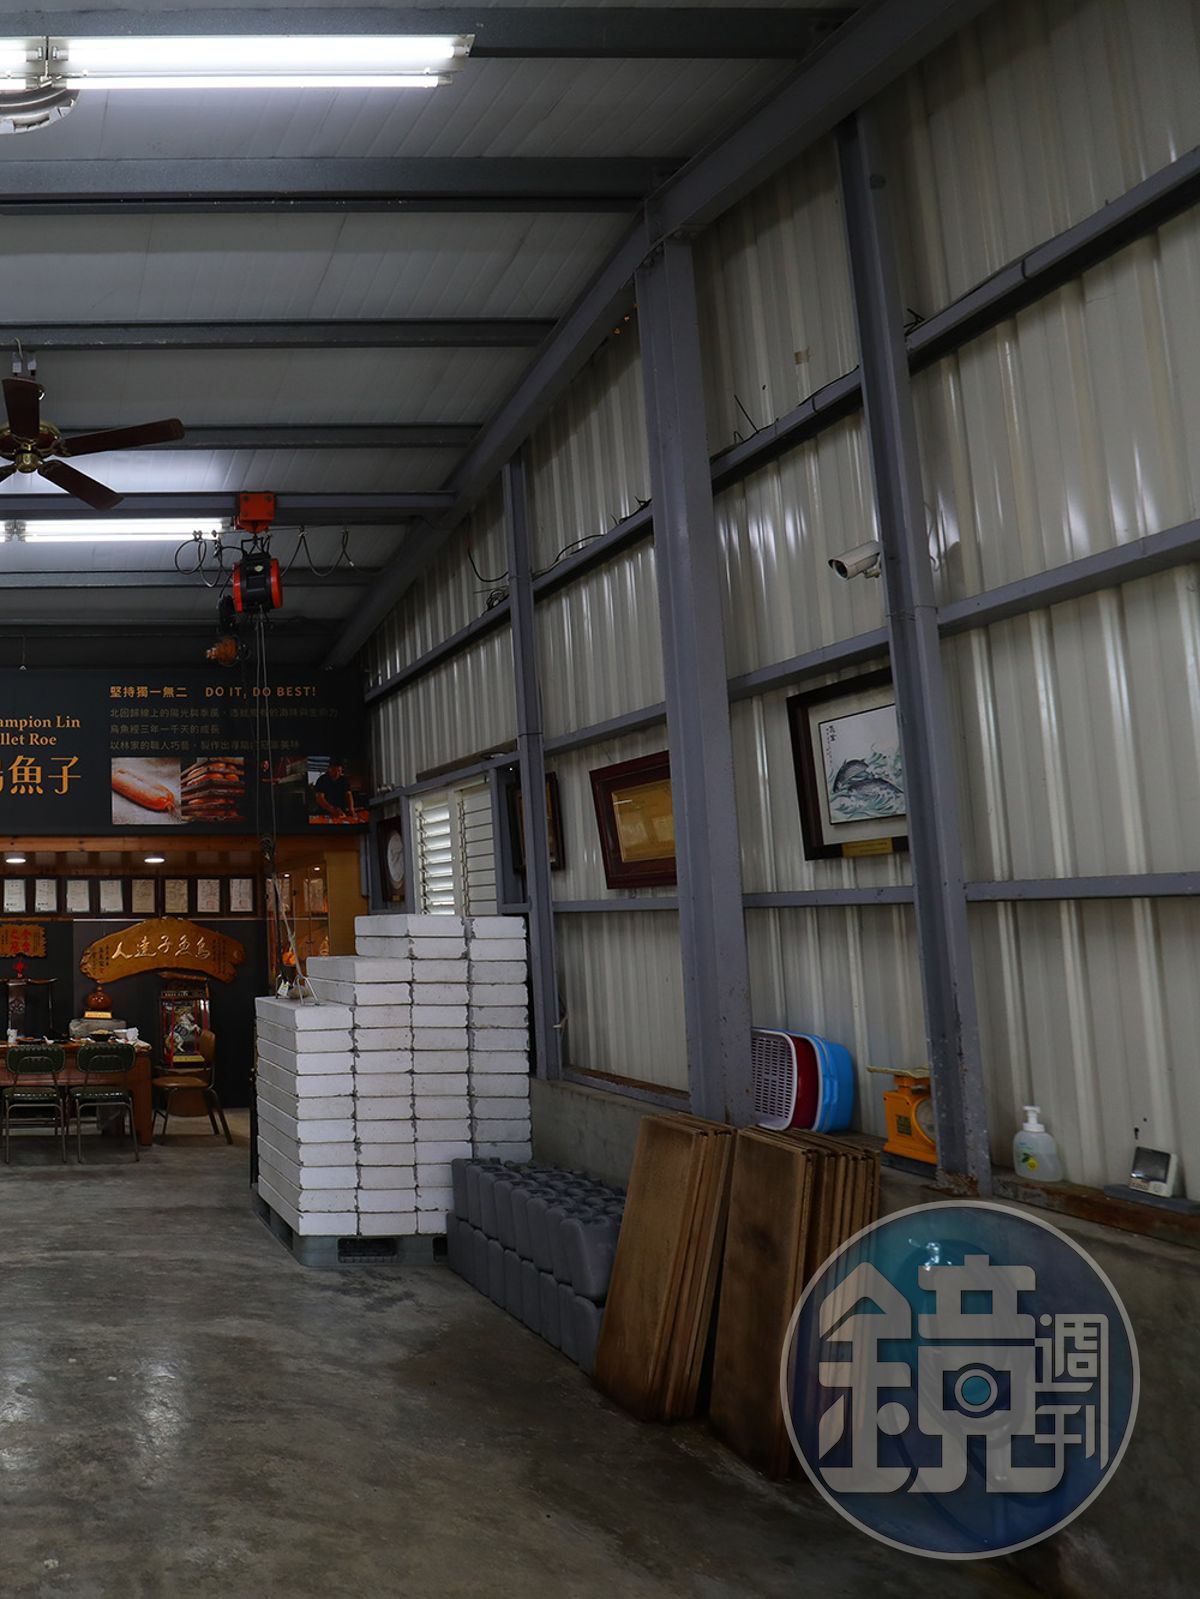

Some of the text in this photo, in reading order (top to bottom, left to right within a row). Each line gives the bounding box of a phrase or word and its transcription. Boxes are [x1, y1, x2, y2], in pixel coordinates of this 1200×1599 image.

[109, 686, 189, 699] 堅持獨一無二
[205, 687, 224, 697] DO
[253, 687, 272, 697] DO
[276, 687, 318, 698] BEST!
[56, 714, 81, 729] Lin
[29, 732, 57, 746] Roe
